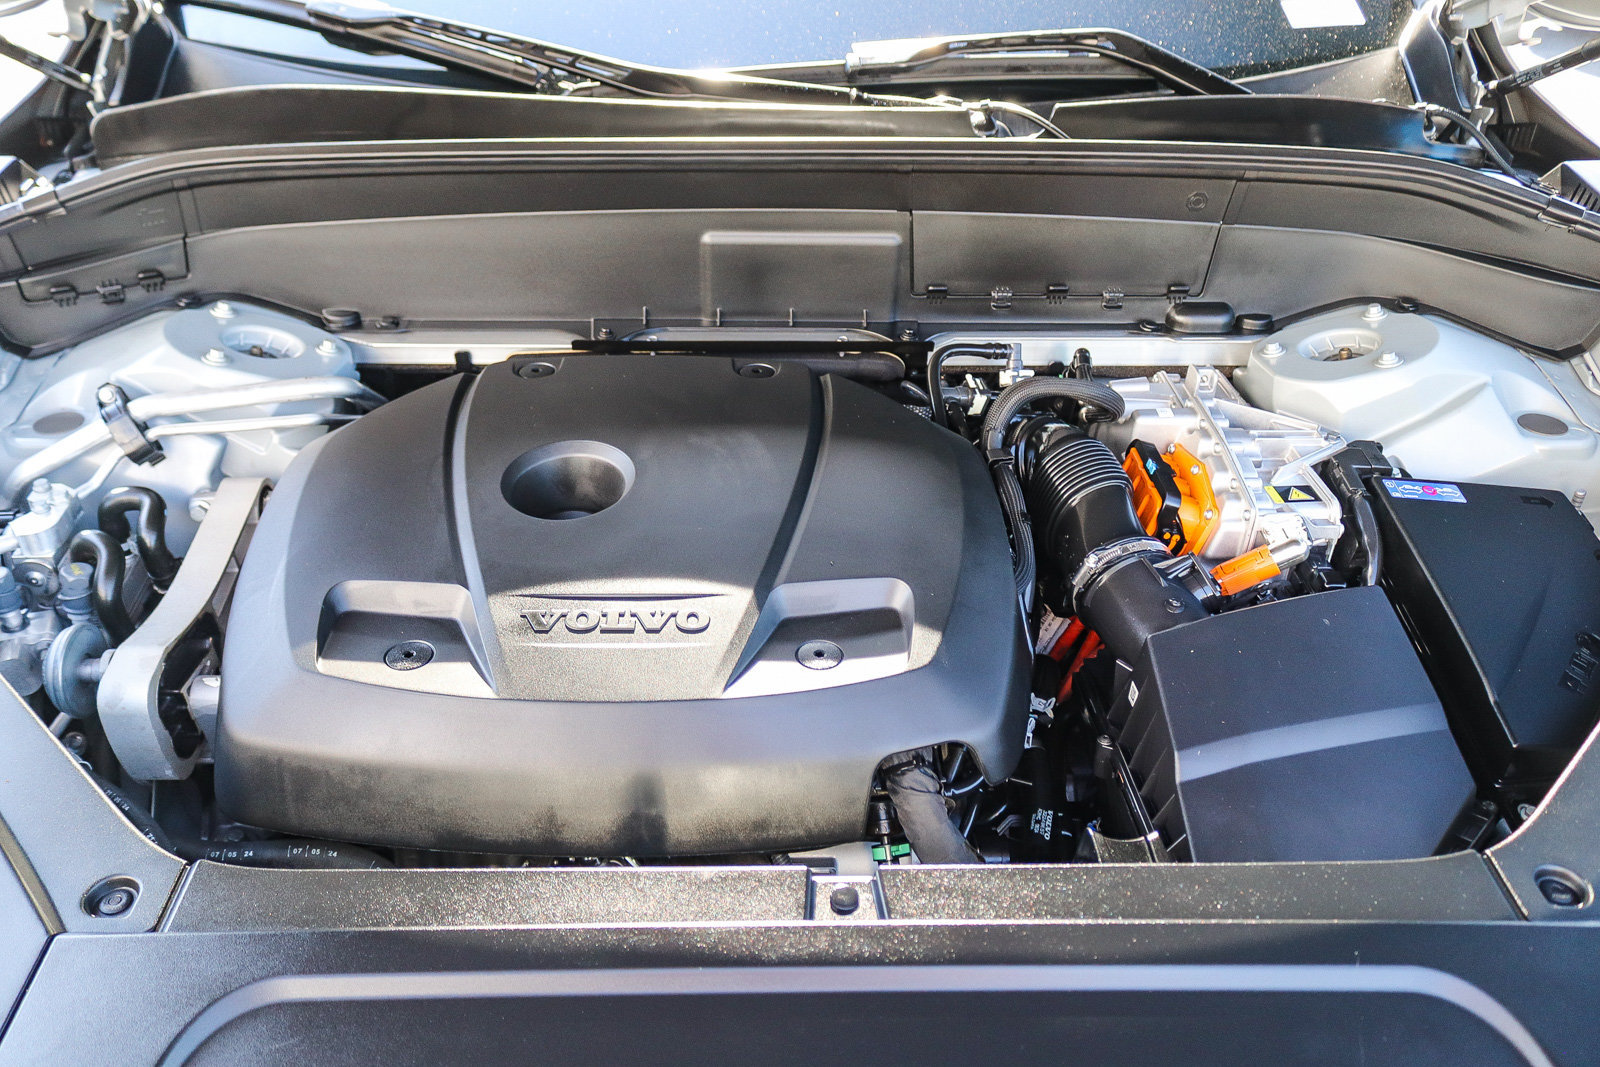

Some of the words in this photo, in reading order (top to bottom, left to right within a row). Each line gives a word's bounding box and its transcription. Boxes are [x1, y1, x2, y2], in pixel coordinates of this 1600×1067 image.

[520, 608, 711, 635] VOLVO
[1044, 810, 1053, 840] VOLVO
[243, 850, 254, 858] 24
[328, 850, 338, 858] 24
